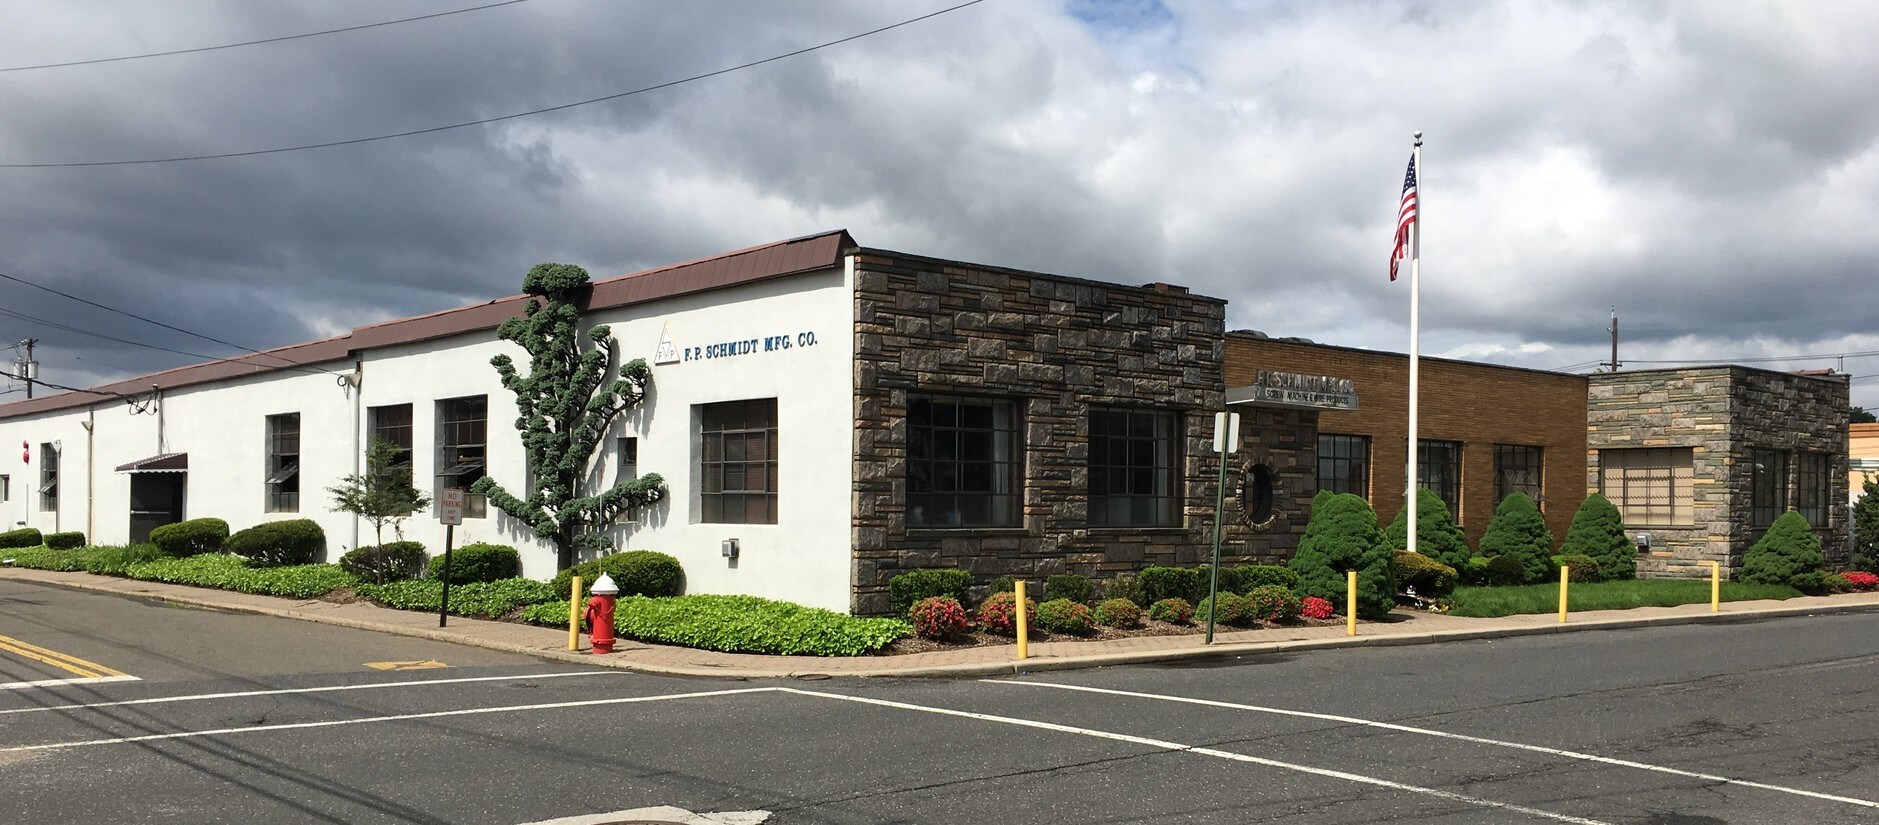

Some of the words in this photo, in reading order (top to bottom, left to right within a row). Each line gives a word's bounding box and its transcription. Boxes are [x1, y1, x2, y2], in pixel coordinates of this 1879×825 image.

[706, 339, 758, 359] SCHMIDT
[764, 335, 792, 352] MFG.
[798, 331, 818, 348] CO.
[1267, 390, 1284, 400] SCREW
[1326, 395, 1349, 405] PRODUCTS
[448, 492, 457, 500] NO
[442, 500, 463, 508] PARKING
